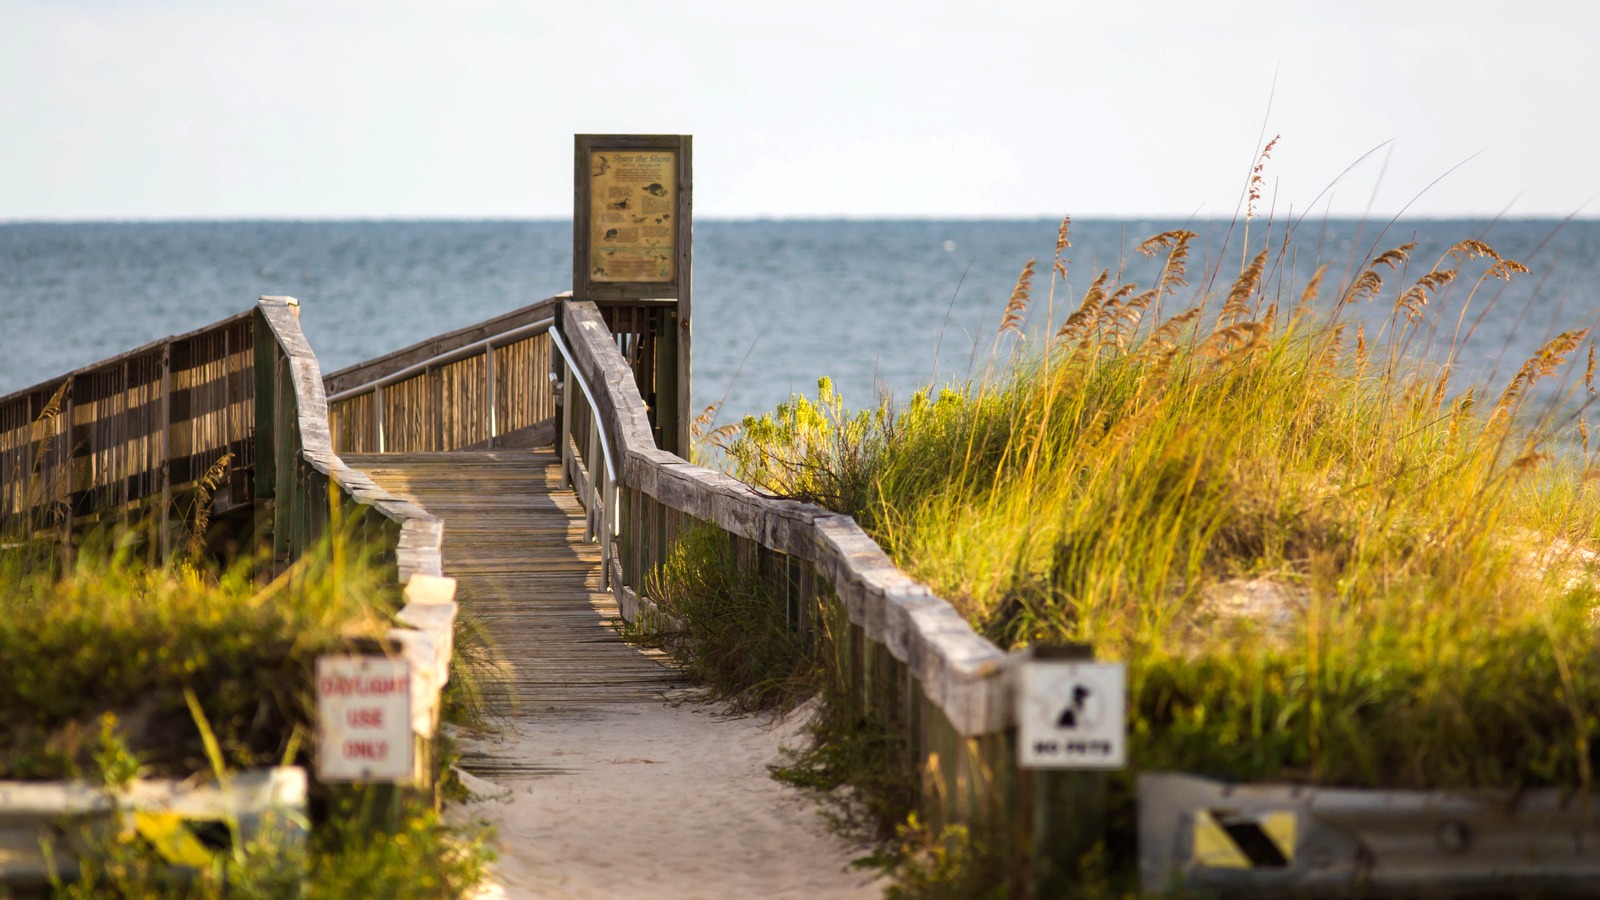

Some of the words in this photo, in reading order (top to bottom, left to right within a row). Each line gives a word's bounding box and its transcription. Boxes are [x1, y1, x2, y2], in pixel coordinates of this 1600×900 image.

[613, 154, 634, 163] Share
[636, 154, 648, 162] the
[650, 154, 671, 162] Shore
[321, 677, 410, 696] DAYLIGHT
[346, 708, 383, 728] USE
[344, 741, 389, 759] ONLY
[1034, 741, 1058, 756] NO
[1066, 741, 1111, 756] PETS
